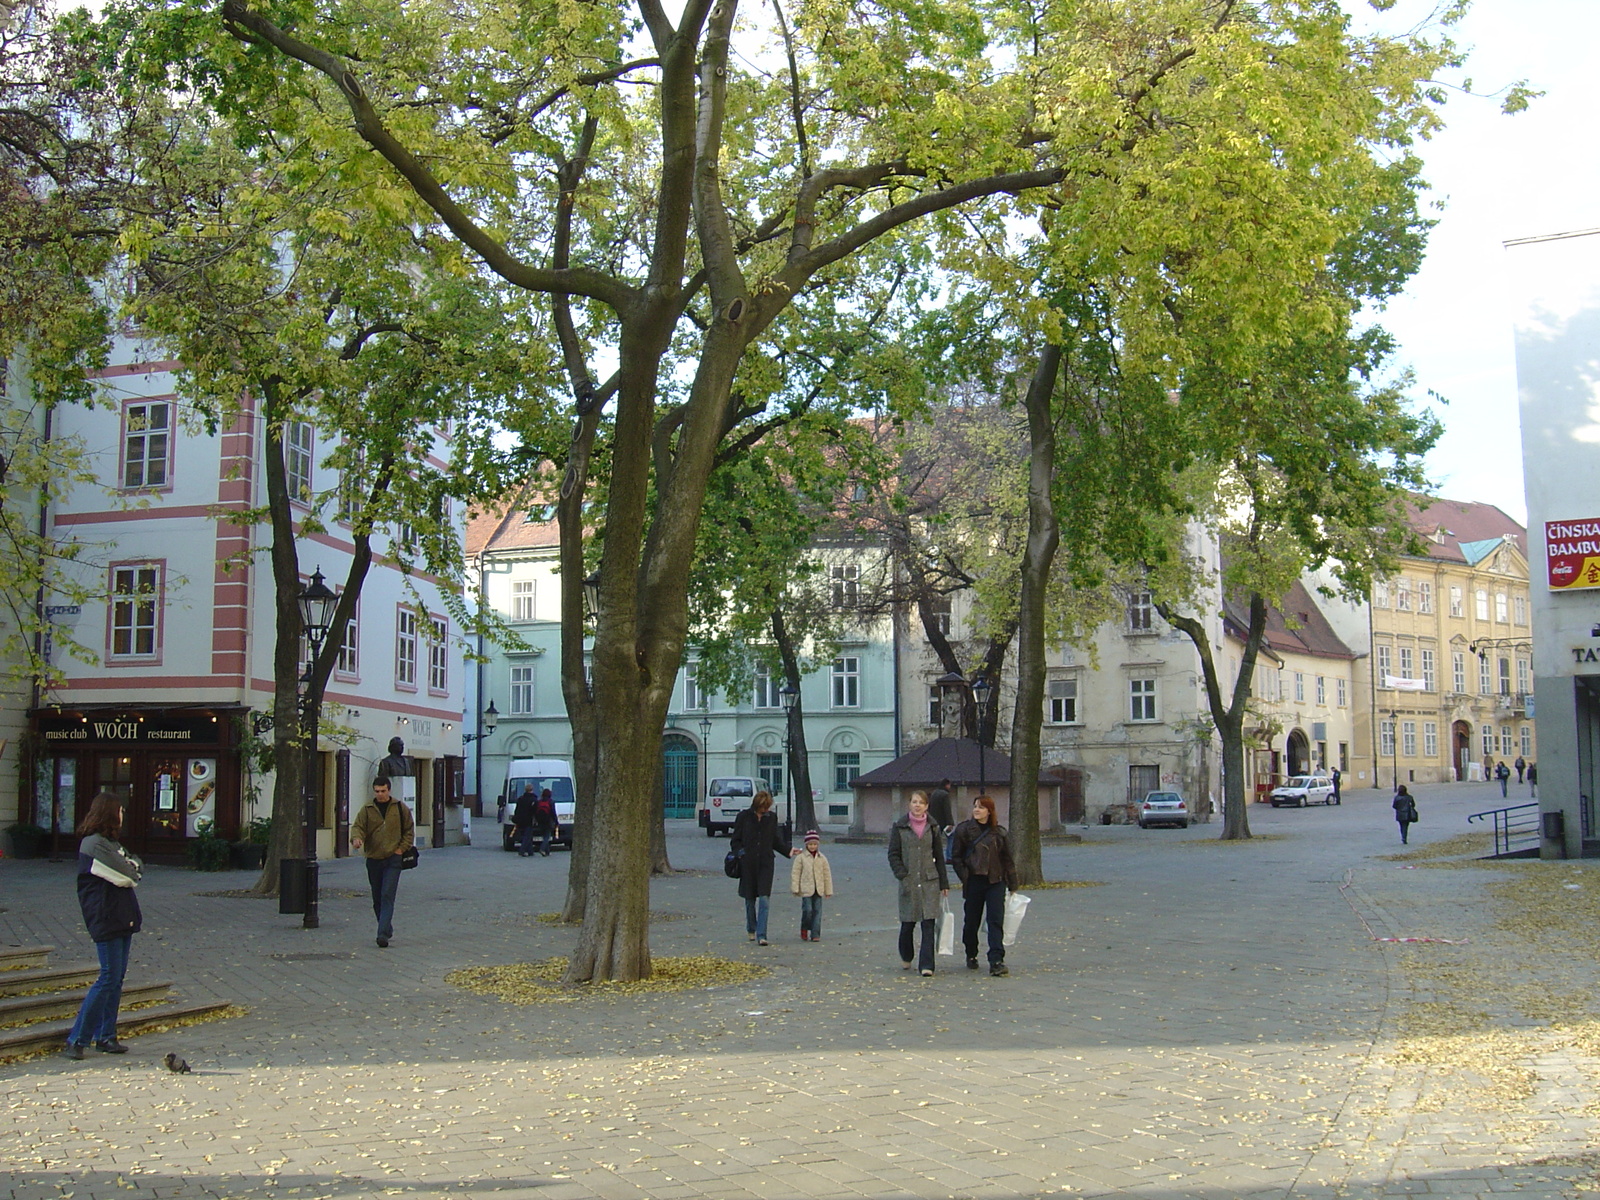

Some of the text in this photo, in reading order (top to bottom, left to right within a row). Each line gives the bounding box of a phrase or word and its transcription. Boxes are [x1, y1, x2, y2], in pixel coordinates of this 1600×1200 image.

[1572, 647, 1600, 663] TA
[45, 722, 191, 739] music club WOCH restaurant
[411, 719, 431, 737] WOCH
